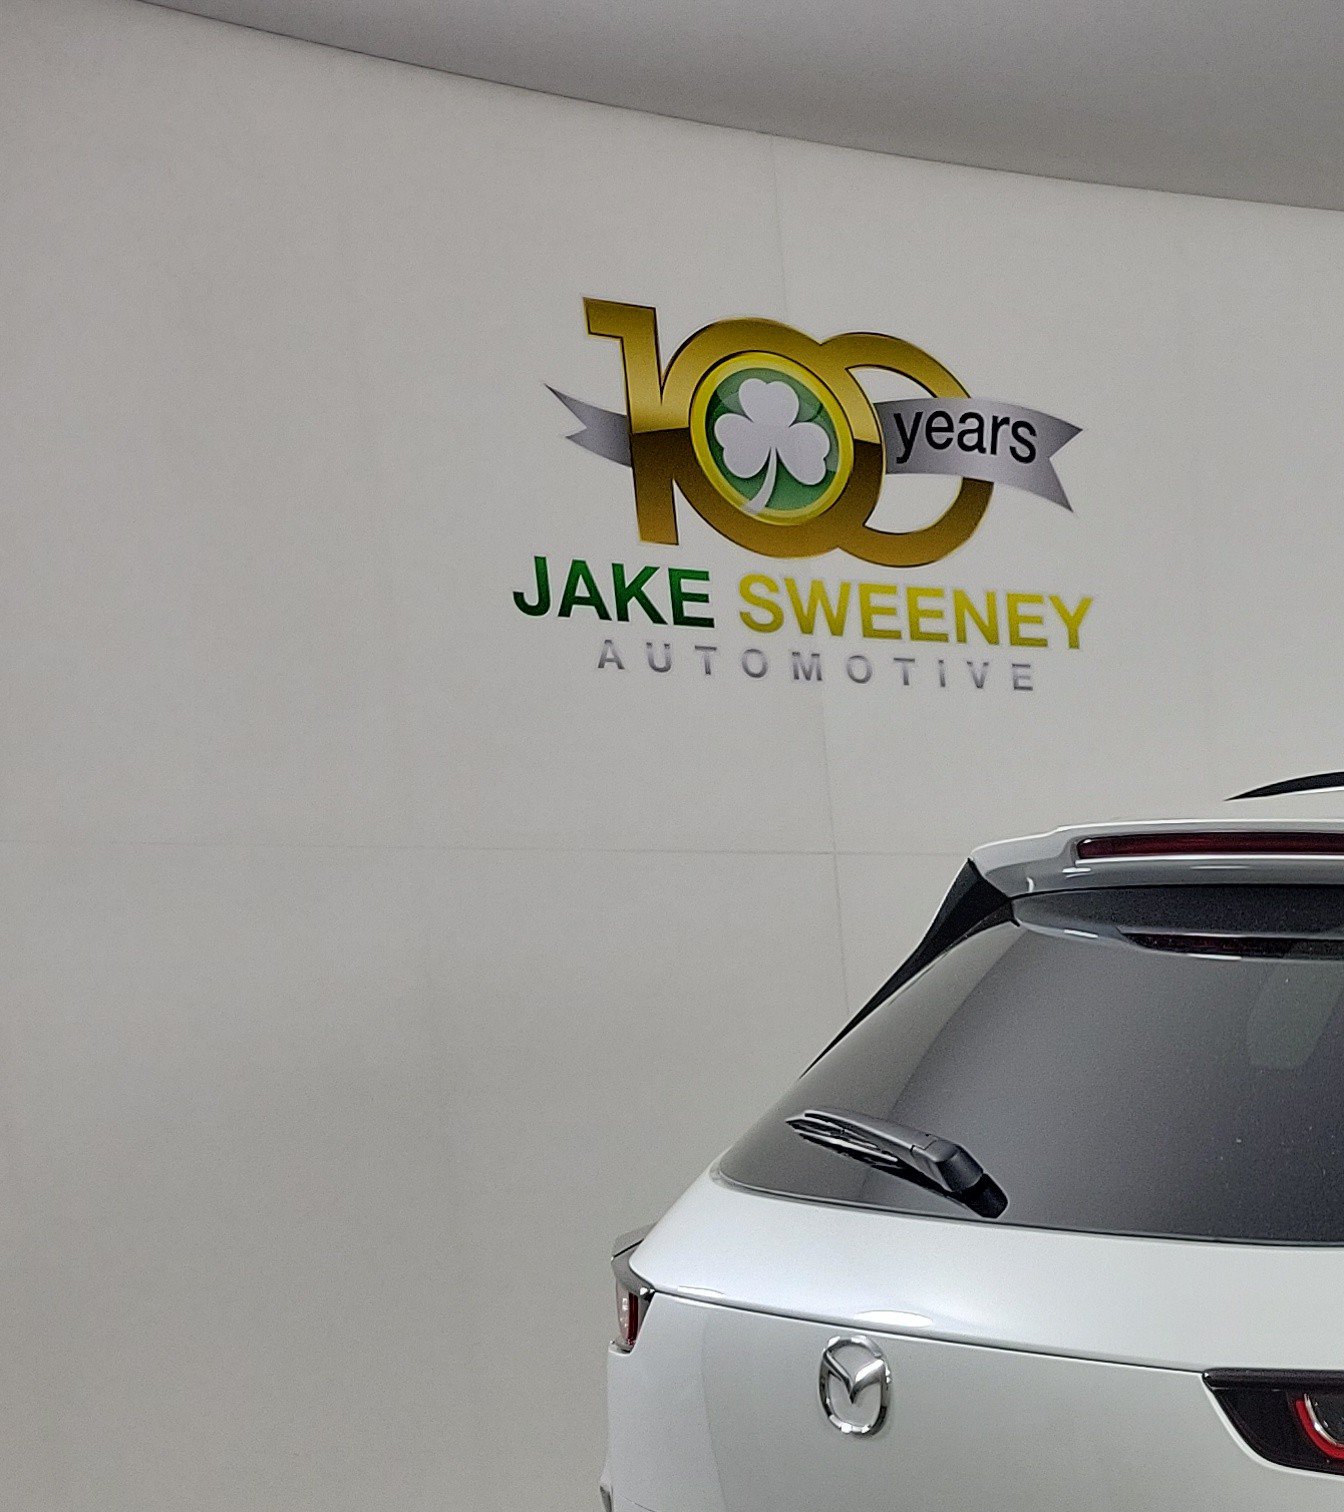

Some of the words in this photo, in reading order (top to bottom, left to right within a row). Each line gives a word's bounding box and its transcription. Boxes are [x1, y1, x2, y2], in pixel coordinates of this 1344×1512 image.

[582, 297, 994, 568] 100
[894, 407, 1038, 464] years
[512, 556, 716, 628] JAKE
[738, 574, 1094, 649] SWEENEY
[597, 638, 1034, 691] AUTOMOTIVE
